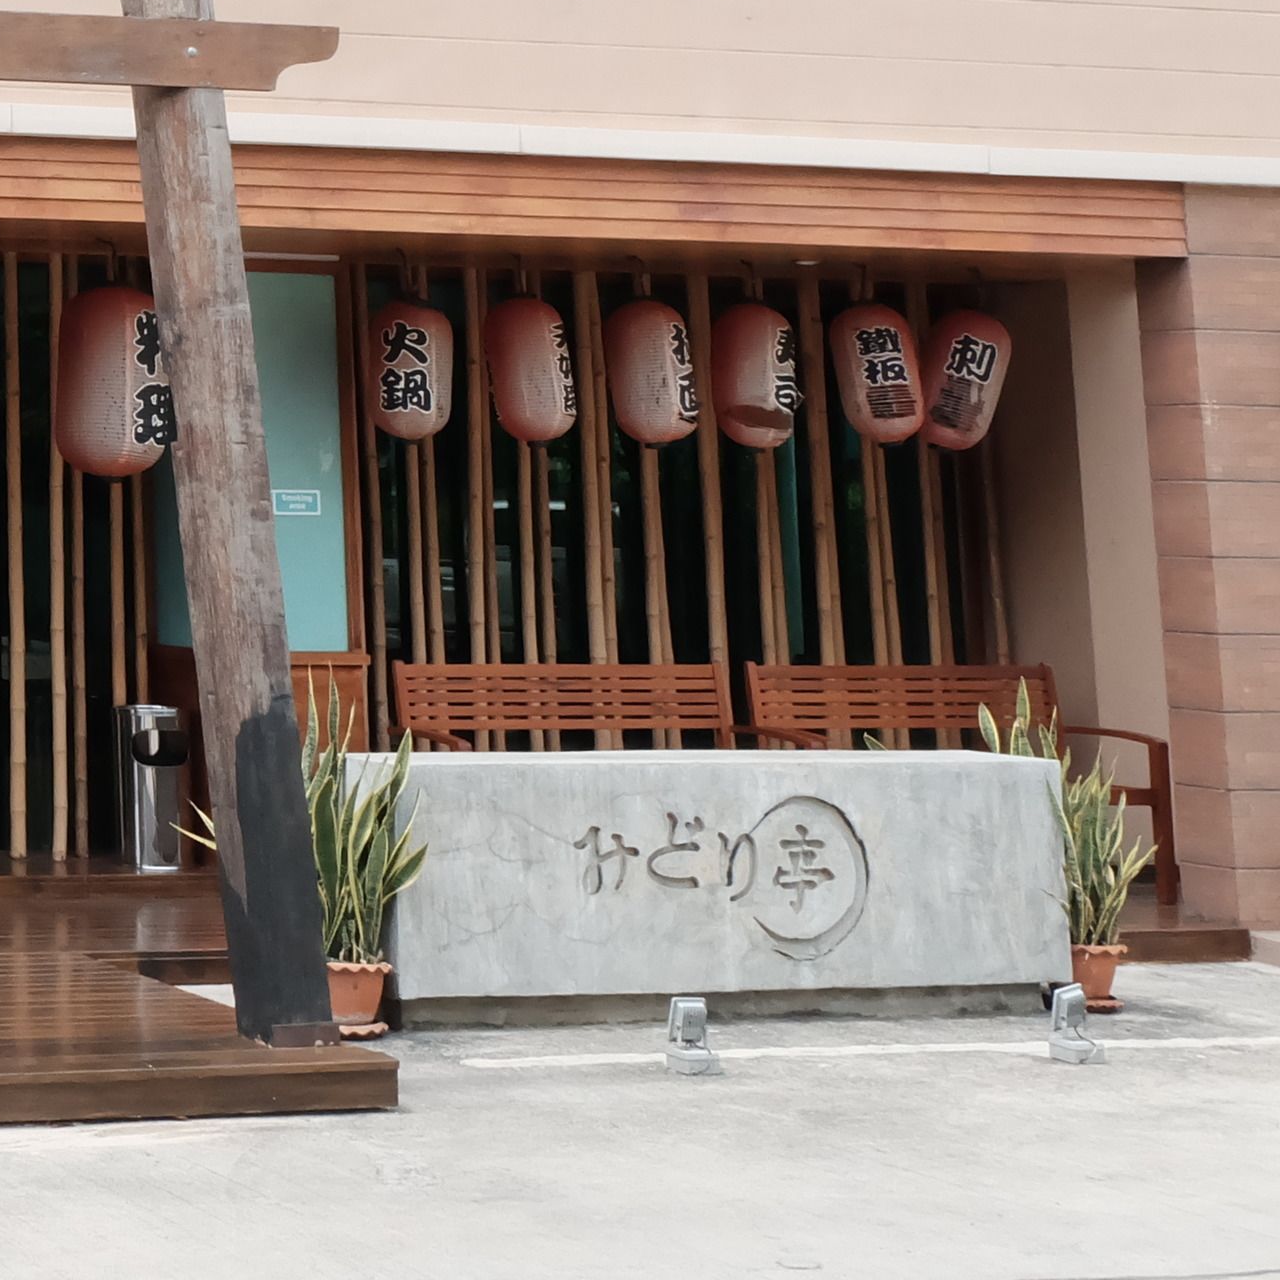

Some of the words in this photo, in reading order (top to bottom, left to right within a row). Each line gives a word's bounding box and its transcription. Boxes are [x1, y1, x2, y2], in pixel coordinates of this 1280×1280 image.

[380, 320, 432, 414] 火鍋
[855, 327, 916, 419] 鐵板
[573, 811, 835, 914] みどり亭
